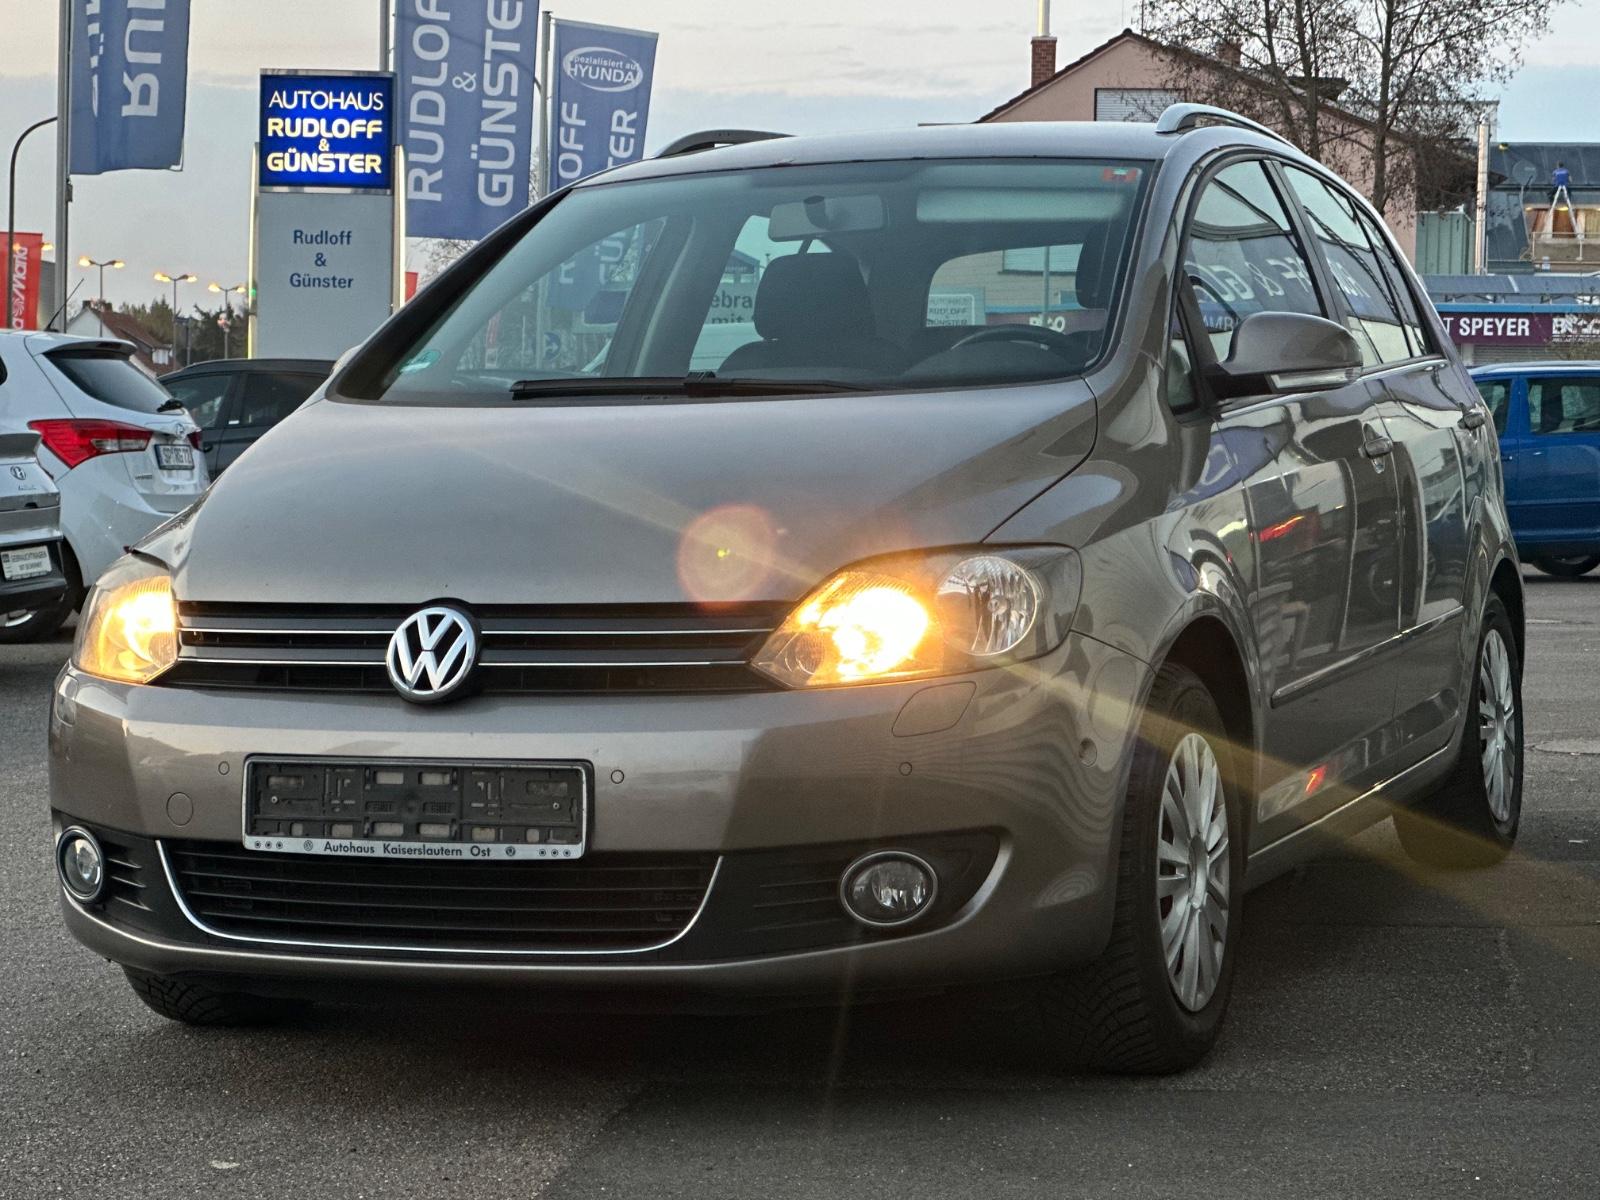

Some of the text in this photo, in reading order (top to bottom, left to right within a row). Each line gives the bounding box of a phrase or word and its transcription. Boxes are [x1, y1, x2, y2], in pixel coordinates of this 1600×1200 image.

[452, 71, 477, 93] &
[268, 90, 384, 111] AUTOHAUS
[267, 117, 383, 139] RUDLOFF
[318, 138, 330, 152] &
[558, 101, 587, 179] OFF
[266, 147, 382, 174] GÜNSTER
[293, 229, 353, 245] Rudloff
[314, 252, 327, 267] &
[289, 272, 354, 289] Günster
[1459, 317, 1530, 336] SPEYER
[323, 840, 491, 858] Autohaus Kaiserslautern Ost
